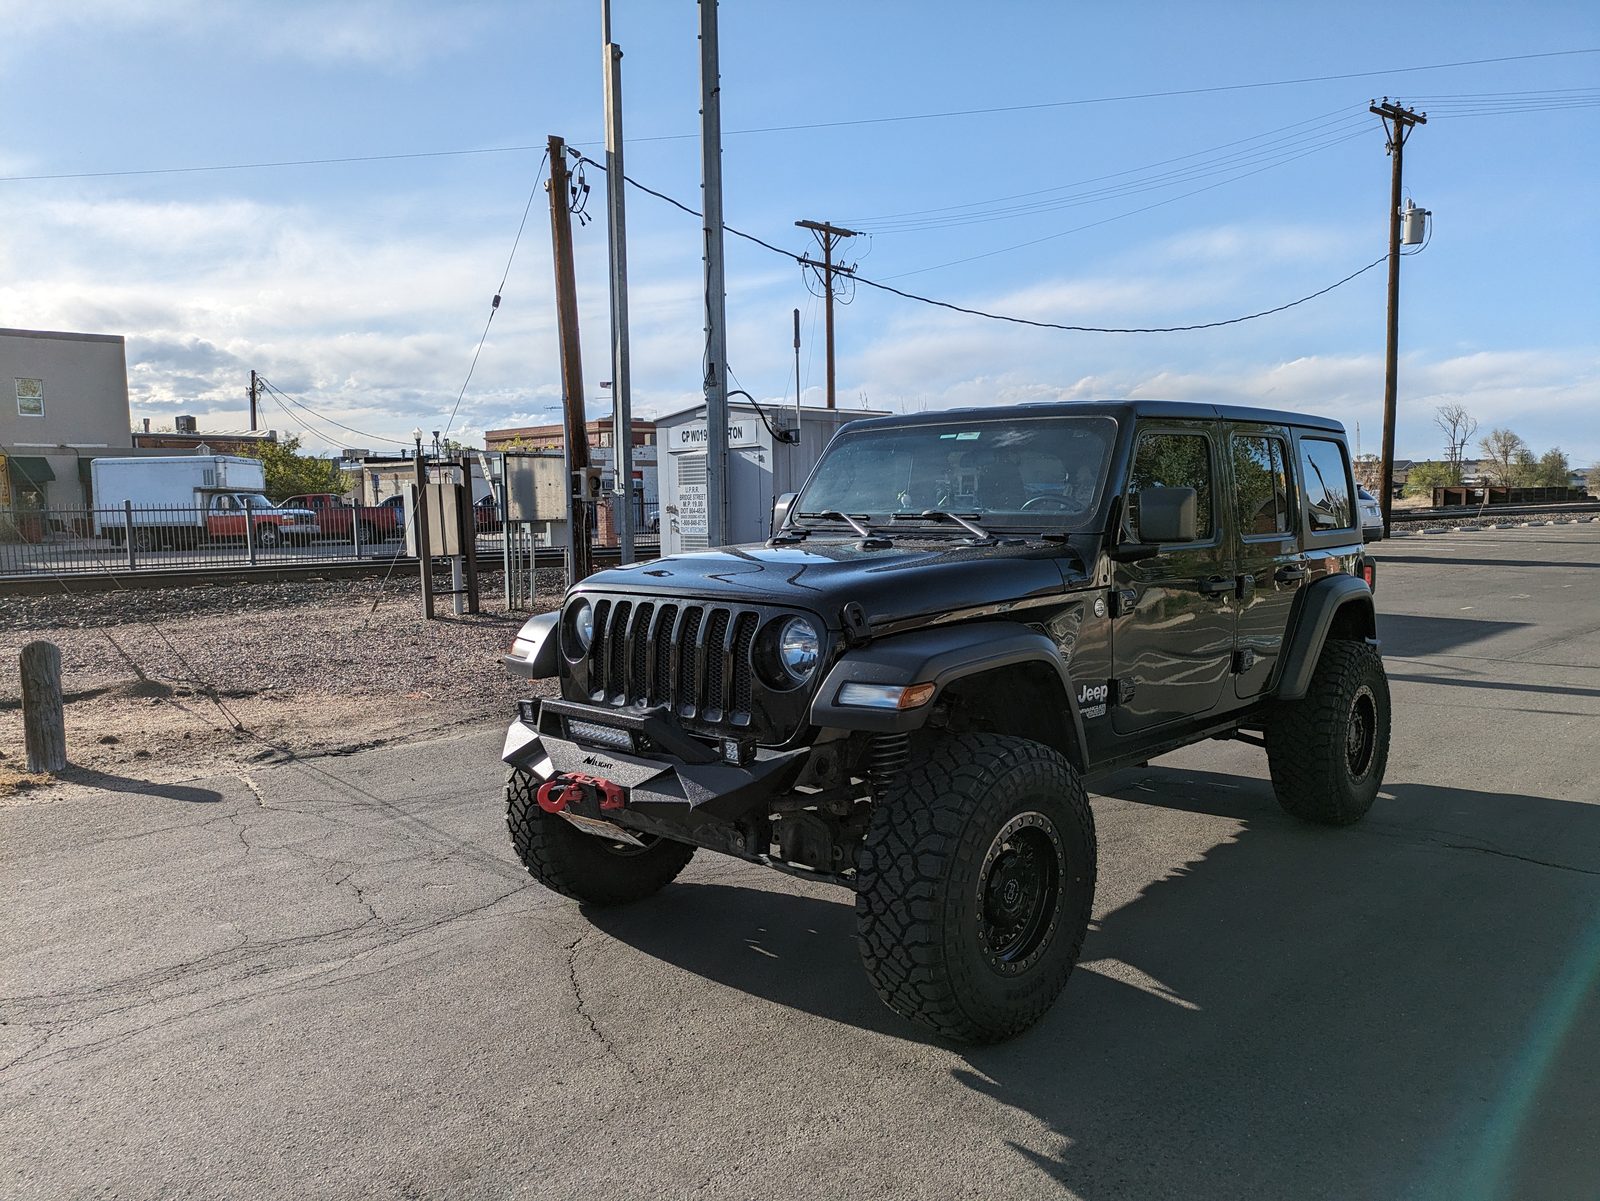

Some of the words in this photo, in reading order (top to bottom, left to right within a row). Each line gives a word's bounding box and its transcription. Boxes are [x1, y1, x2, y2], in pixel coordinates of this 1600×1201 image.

[681, 430, 690, 443] CP
[692, 493, 706, 501] STREET
[1077, 684, 1108, 703] Jeep
